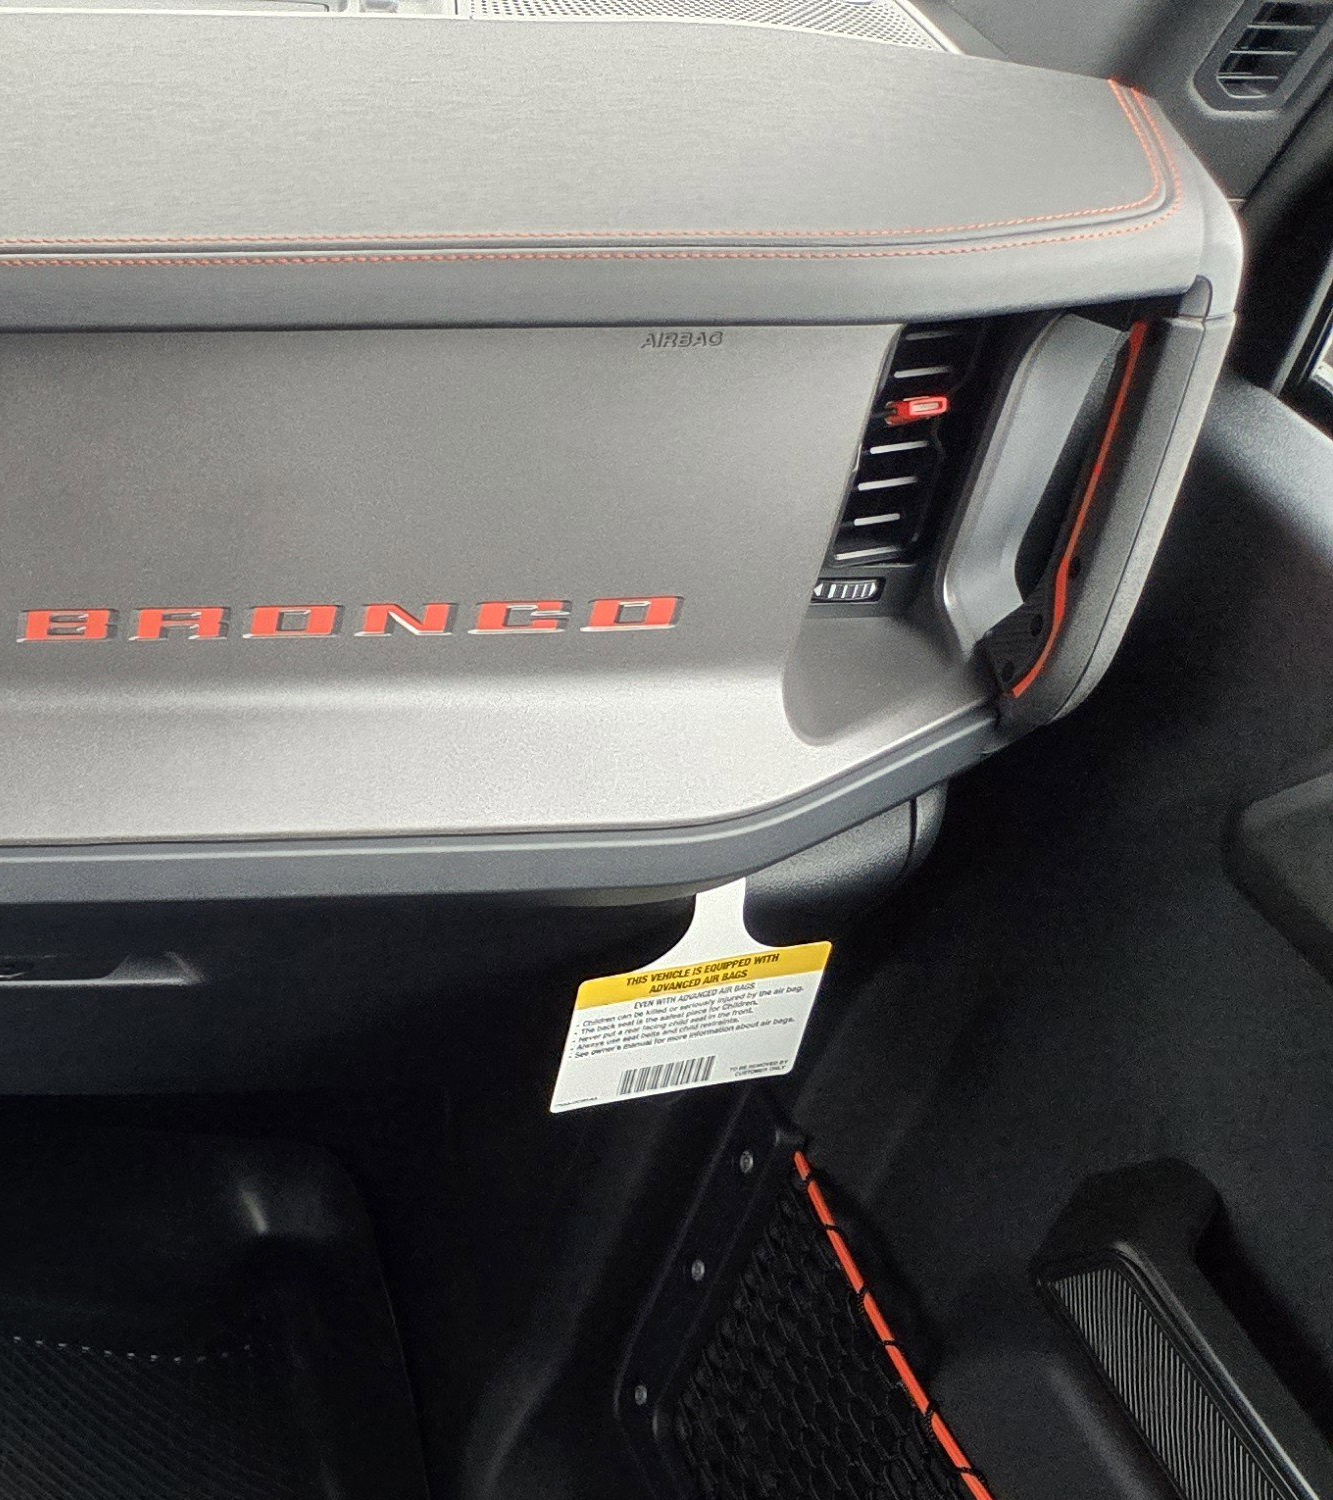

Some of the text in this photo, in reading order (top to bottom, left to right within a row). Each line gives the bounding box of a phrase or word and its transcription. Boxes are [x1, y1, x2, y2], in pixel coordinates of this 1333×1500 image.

[641, 331, 723, 349] AIRBAG
[17, 595, 685, 642] BRONCO
[626, 953, 780, 986] THIS VEHICLE IS EQUIPPED WITH
[649, 970, 748, 994] ADVANCED AIR BAGS
[583, 1016, 616, 1027] Children
[634, 1011, 644, 1019] be
[645, 1007, 667, 1016] killed
[679, 1000, 715, 1011] seriously
[717, 992, 745, 1005] injured
[746, 990, 758, 999] by
[759, 988, 772, 997] the
[773, 987, 784, 995] air
[785, 985, 804, 995] bag.
[633, 982, 756, 1010] EVEN WITH ADVANCED AIR BAGS
[597, 1024, 615, 1032] back
[617, 1021, 634, 1029] seat
[660, 1012, 684, 1021] safest
[686, 1008, 707, 1018] place
[709, 1004, 720, 1012] for
[722, 1000, 758, 1011] Children.
[602, 1031, 616, 1039] put
[642, 1023, 667, 1033] facing
[668, 1019, 689, 1027] child
[574, 1051, 589, 1059] See
[623, 1040, 653, 1050] manual
[654, 1036, 665, 1044] for
[666, 1034, 688, 1042] more
[688, 1025, 734, 1038] information
[735, 1021, 759, 1030] about
[760, 1018, 772, 1026] air
[576, 1040, 604, 1050] Always
[623, 1034, 639, 1042] seat
[640, 1031, 660, 1039] belts
[662, 1028, 677, 1036] and
[679, 1024, 699, 1032] child
